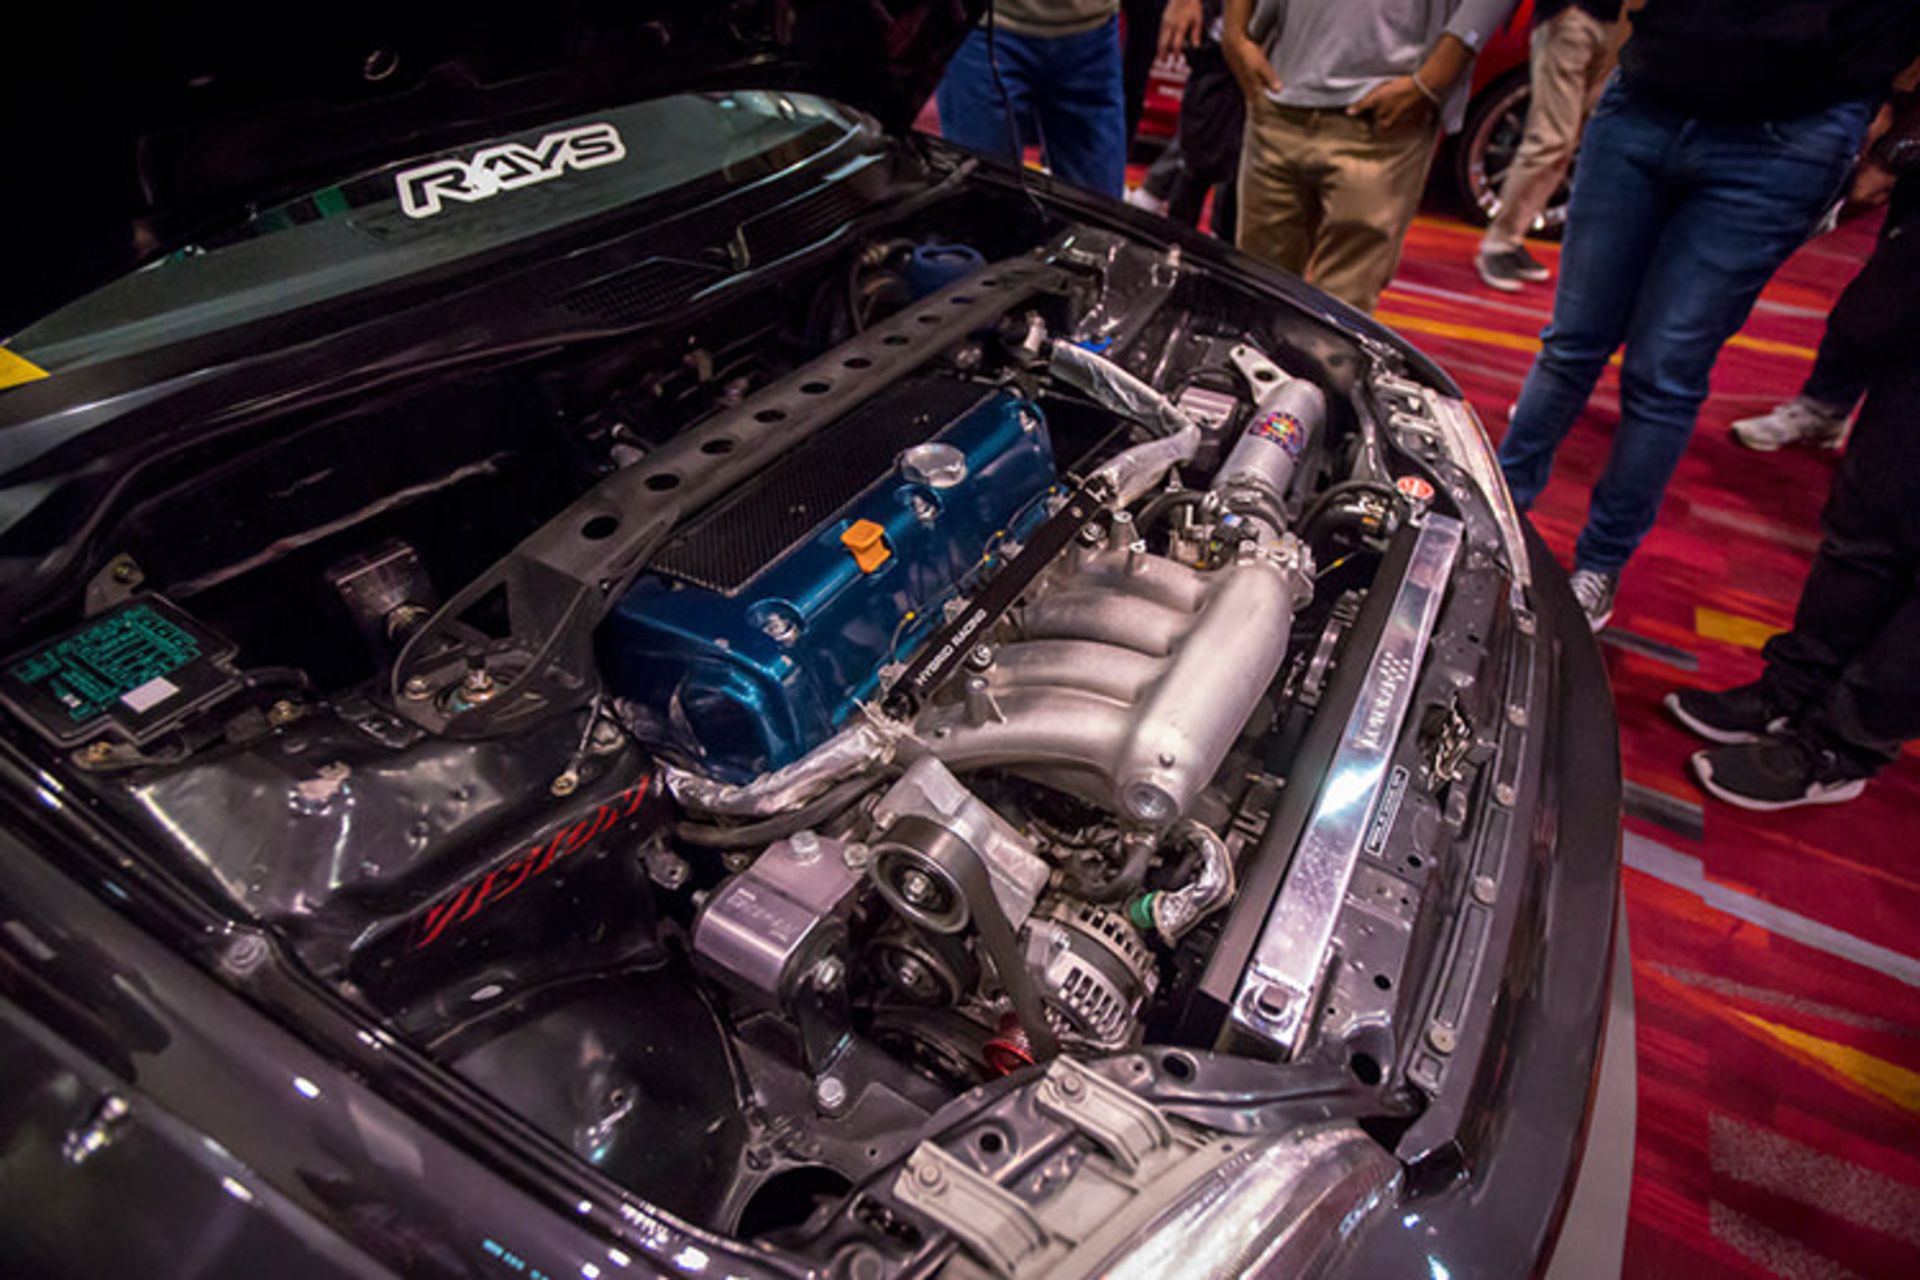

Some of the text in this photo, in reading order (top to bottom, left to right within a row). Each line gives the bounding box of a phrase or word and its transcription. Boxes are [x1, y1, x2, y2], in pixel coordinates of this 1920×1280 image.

[396, 122, 626, 218] RAYS
[914, 608, 987, 686] HYBRID RACING
